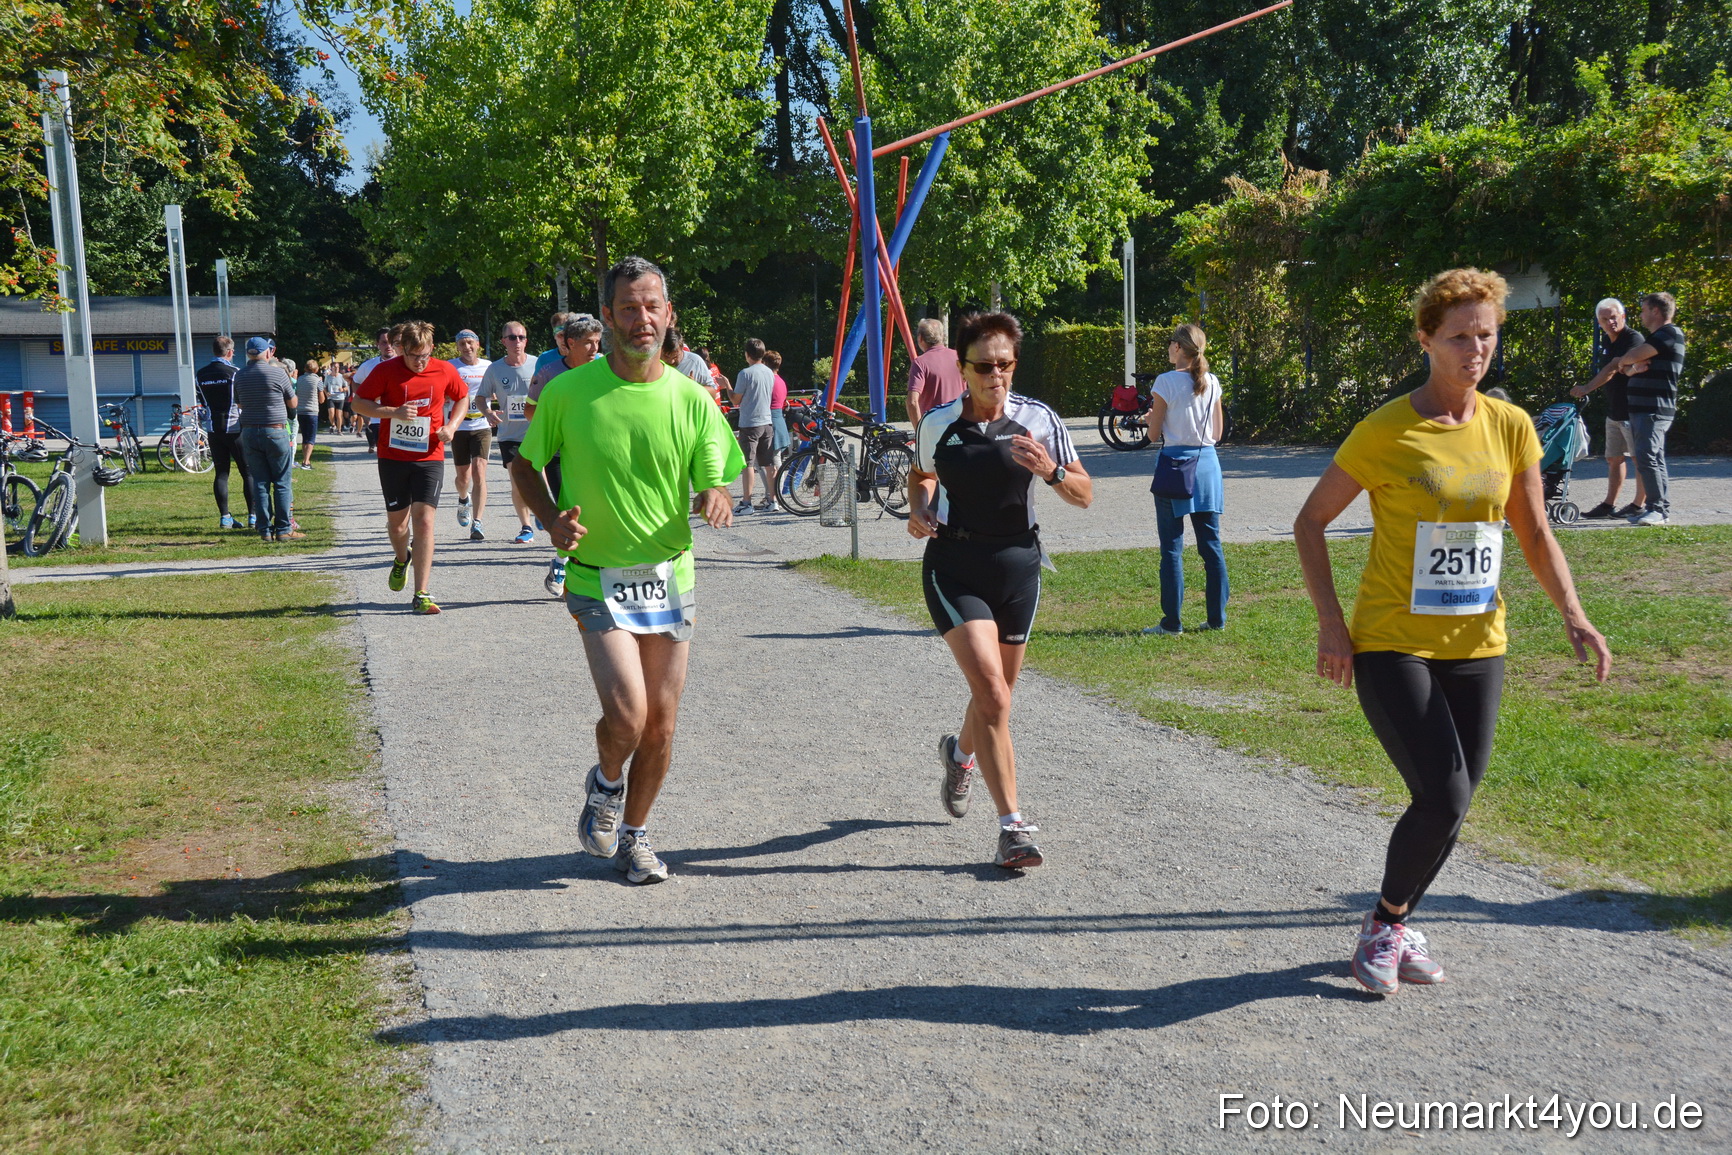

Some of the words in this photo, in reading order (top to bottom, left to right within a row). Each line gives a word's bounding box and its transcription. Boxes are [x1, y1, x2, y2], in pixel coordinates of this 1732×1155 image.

[93, 340, 118, 351] AFE
[511, 402, 526, 411] 219
[395, 424, 424, 438] 2430
[1446, 530, 1483, 540] BOCK
[1429, 546, 1492, 576] 2516
[612, 579, 667, 603] 3103
[1440, 592, 1480, 605] Claudia
